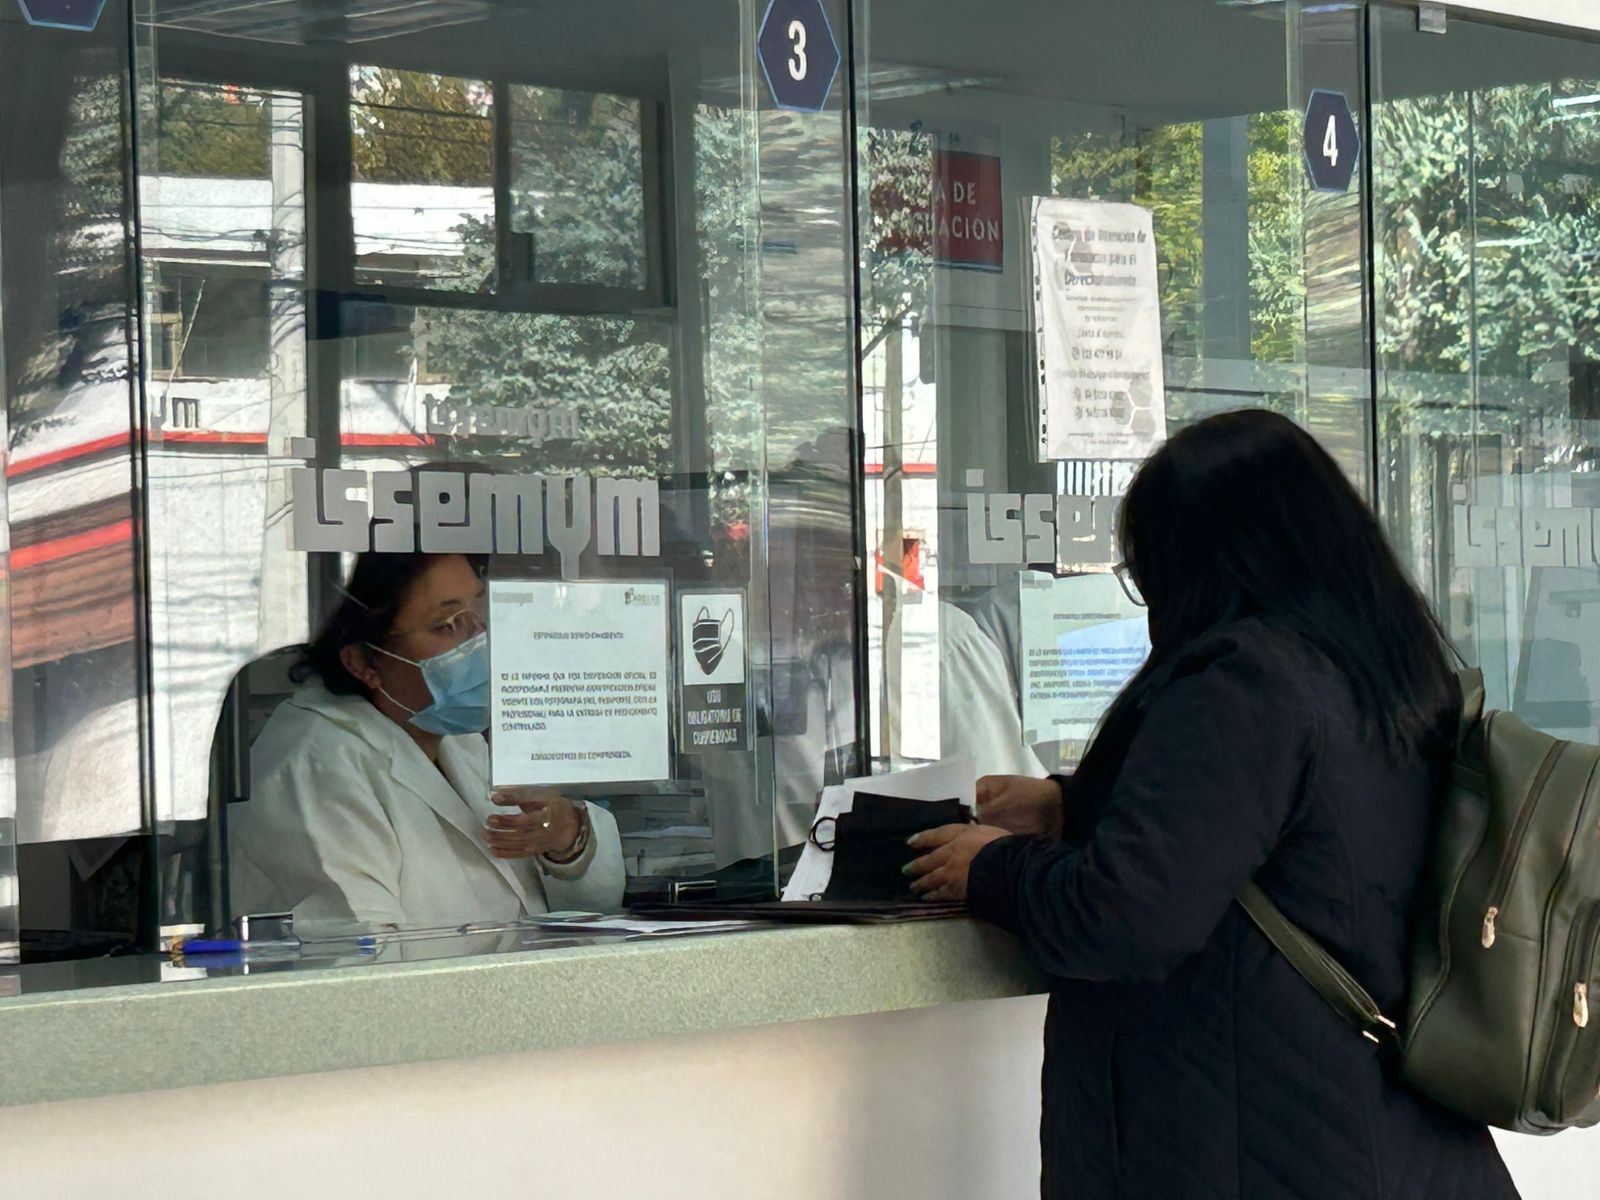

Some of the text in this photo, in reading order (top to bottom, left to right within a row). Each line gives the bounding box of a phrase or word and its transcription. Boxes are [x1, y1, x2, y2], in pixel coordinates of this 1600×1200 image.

[788, 20, 807, 81] 3
[1323, 114, 1338, 167] 4
[953, 181, 977, 205] DE
[291, 437, 660, 579] issemym
